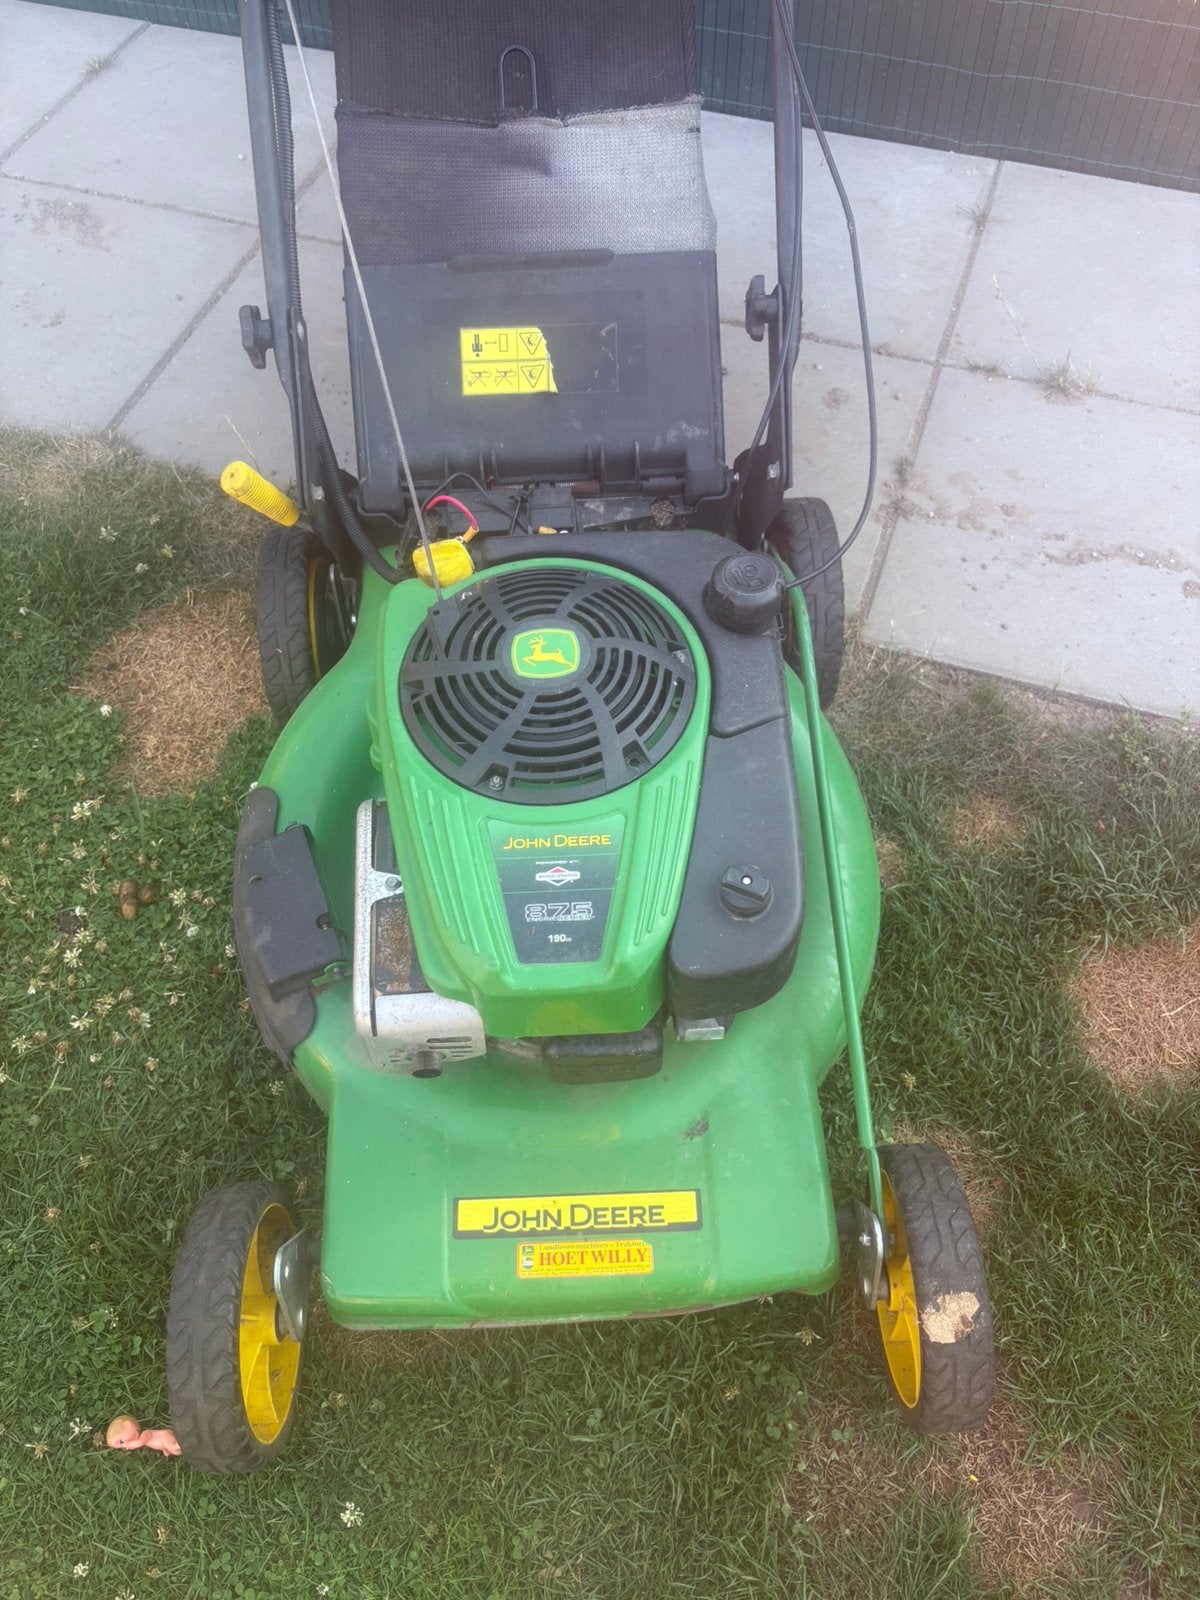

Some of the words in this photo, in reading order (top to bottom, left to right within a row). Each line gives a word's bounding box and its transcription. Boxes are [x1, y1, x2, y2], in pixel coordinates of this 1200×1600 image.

[503, 836, 551, 850] JOHN
[553, 834, 612, 848] DEERE
[524, 901, 593, 920] 875
[482, 1206, 562, 1231] JOHN
[569, 1203, 666, 1228] DEERE
[538, 1250, 588, 1266] HOET
[590, 1248, 648, 1264] WILLY
